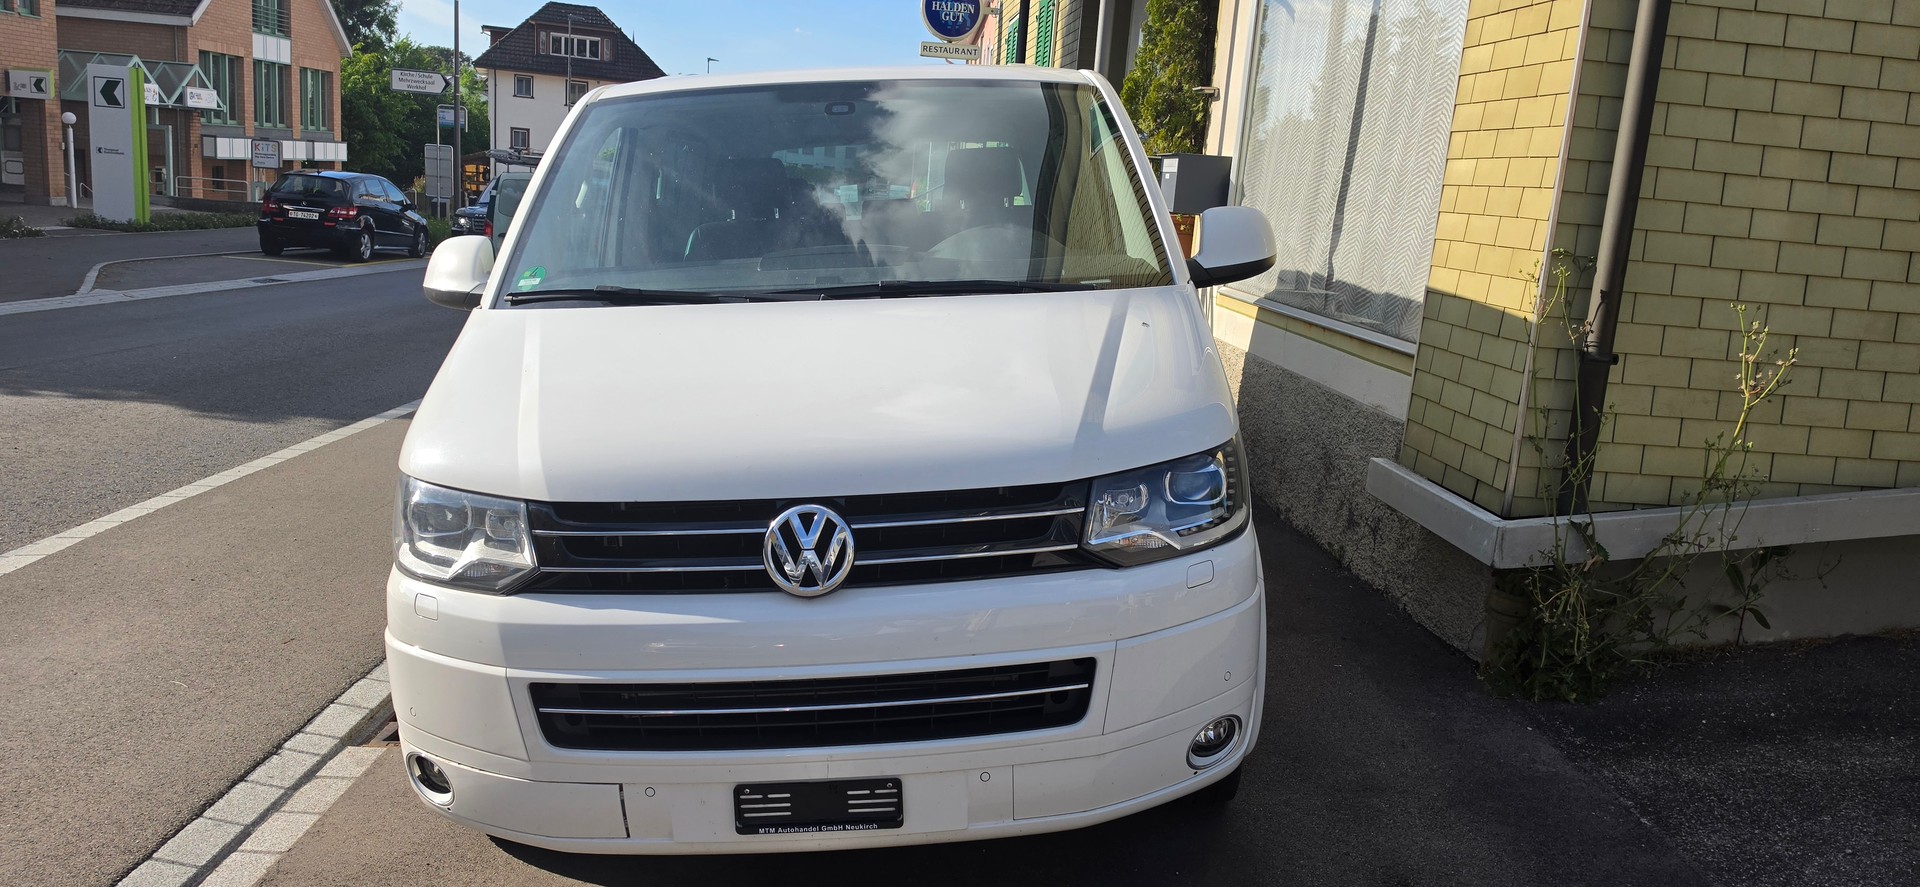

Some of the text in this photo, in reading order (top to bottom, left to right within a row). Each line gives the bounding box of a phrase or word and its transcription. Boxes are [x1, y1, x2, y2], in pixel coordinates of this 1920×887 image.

[931, 1, 975, 14] HALDEN
[941, 11, 965, 22] GUT
[922, 45, 978, 56] RESTAURANT
[406, 83, 427, 91] Werkhof
[777, 825, 820, 834] Autohandel
[821, 824, 844, 832] GmbH
[845, 823, 878, 831] Neukirch
